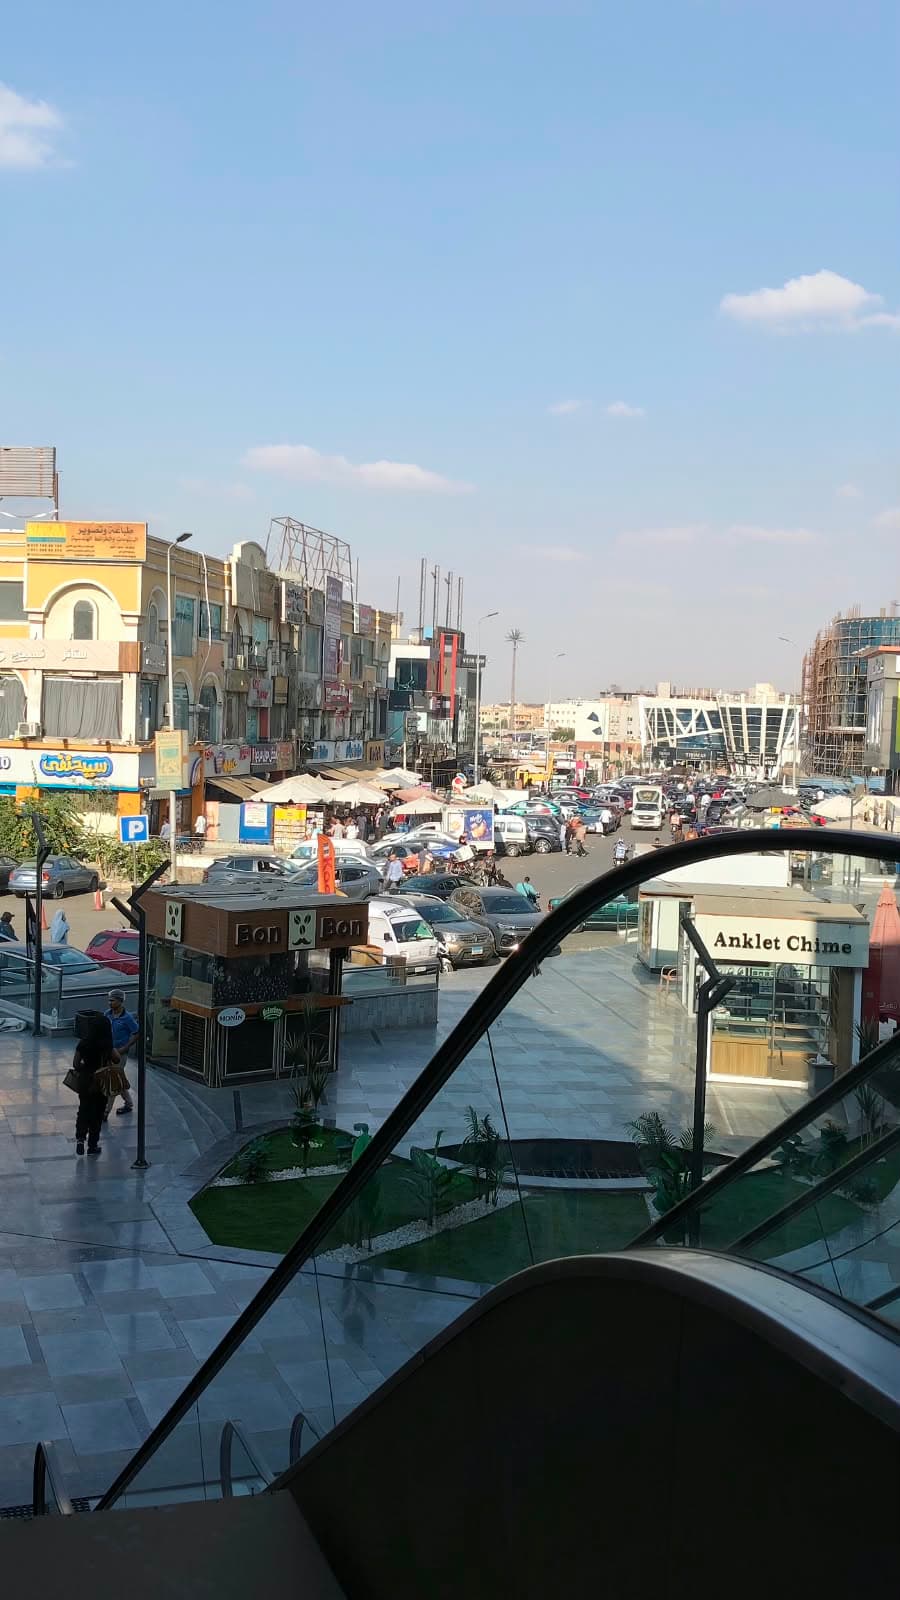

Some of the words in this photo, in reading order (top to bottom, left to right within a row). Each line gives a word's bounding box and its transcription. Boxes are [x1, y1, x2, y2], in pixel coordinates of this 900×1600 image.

[78, 525, 108, 536] وتصوير
[128, 821, 145, 838] P
[234, 923, 280, 946] Bon
[319, 916, 361, 938] Bon
[714, 932, 780, 951] Anklet
[787, 935, 852, 954] Chime
[219, 1012, 244, 1022] MONIN
